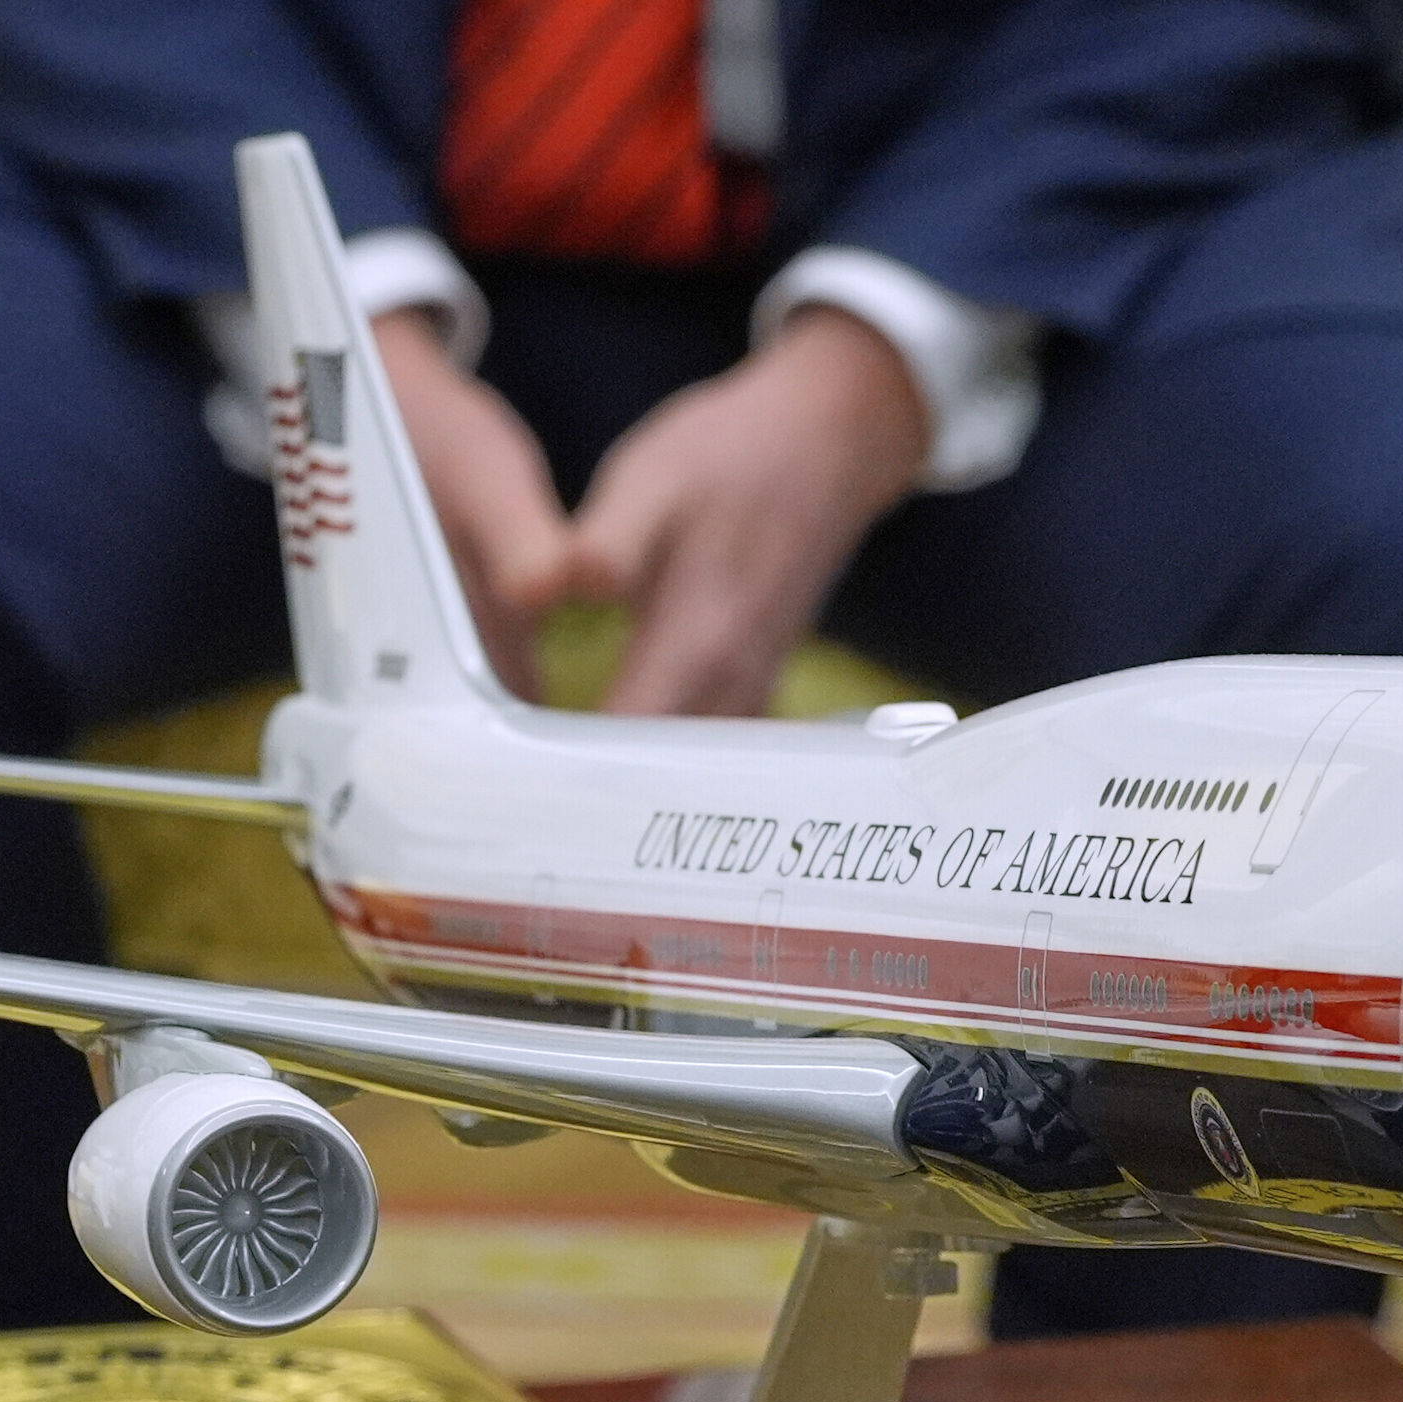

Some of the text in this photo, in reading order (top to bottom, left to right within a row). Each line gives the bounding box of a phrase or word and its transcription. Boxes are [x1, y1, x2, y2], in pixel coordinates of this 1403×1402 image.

[634, 811, 1208, 904] UNITED STATES OF AMERICA
